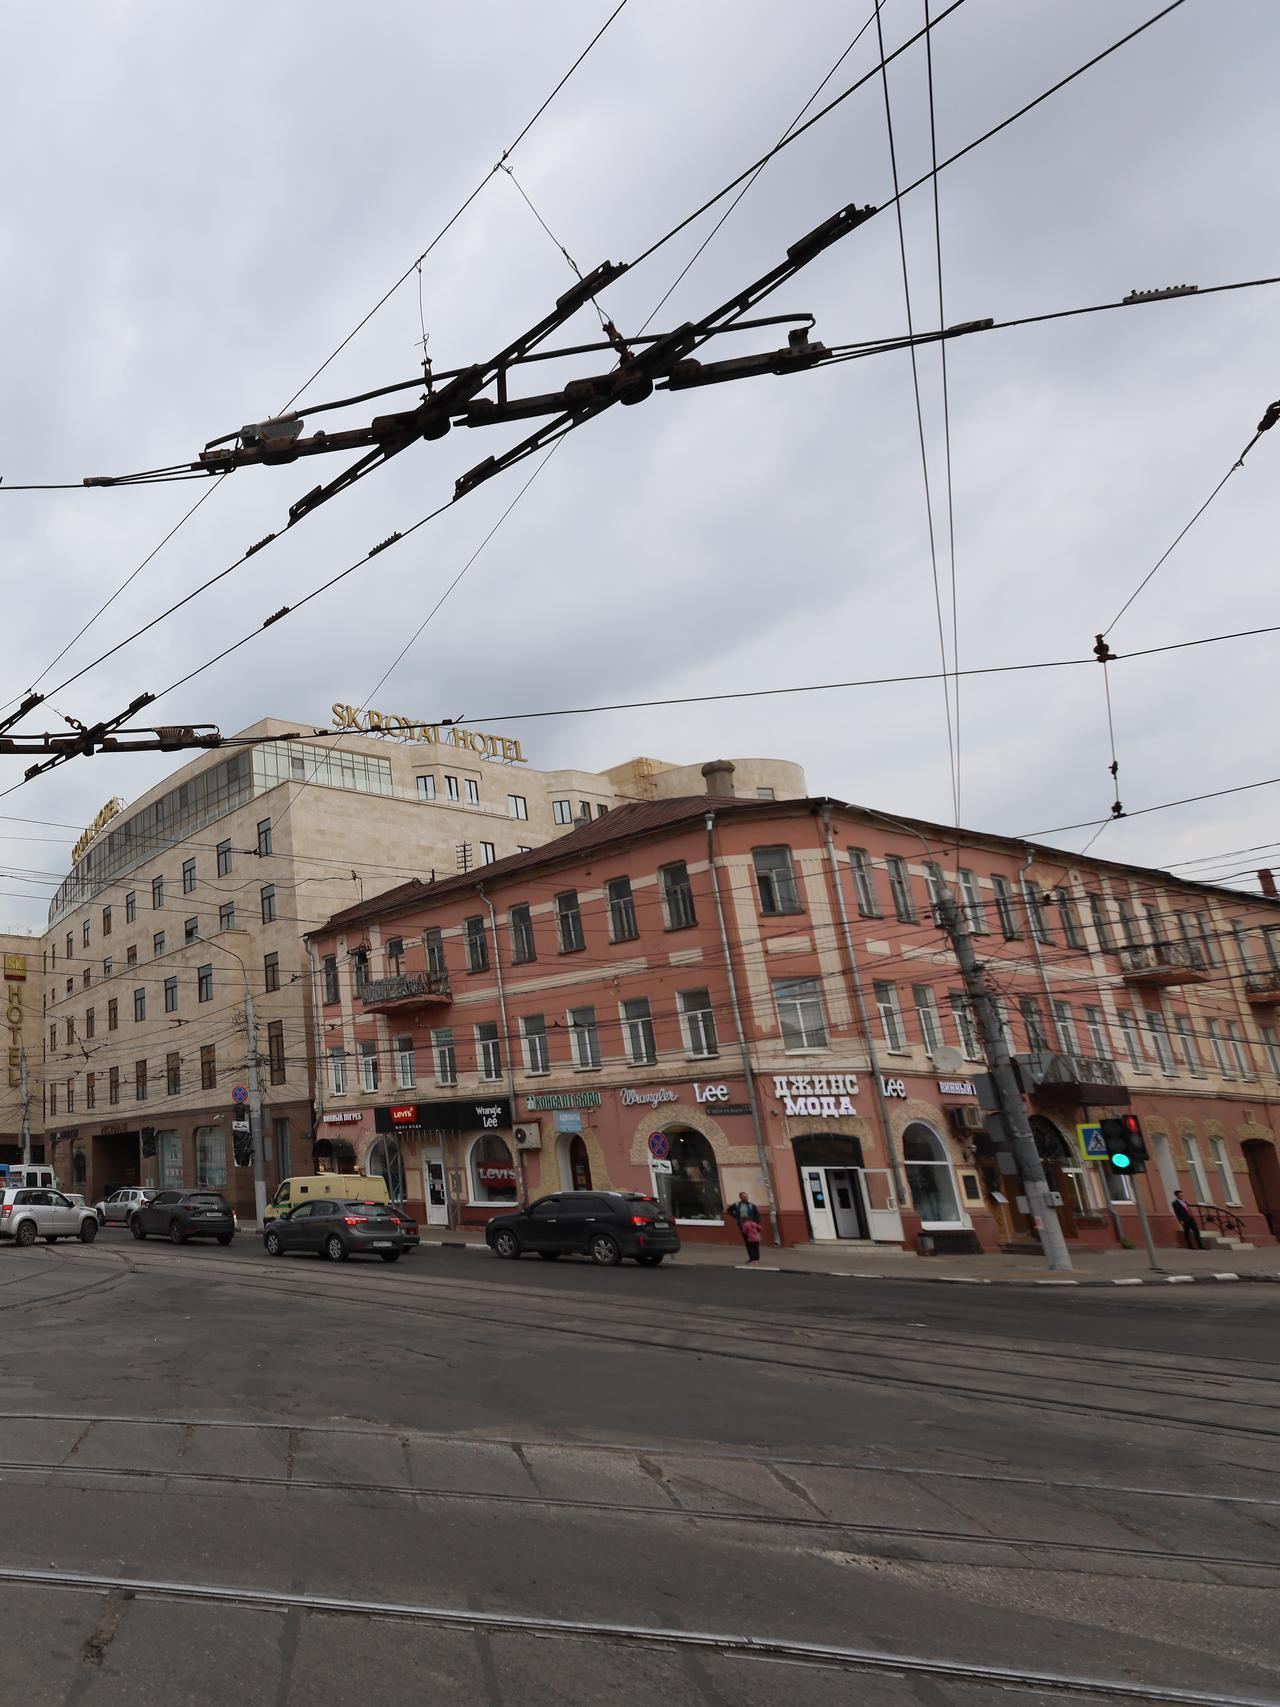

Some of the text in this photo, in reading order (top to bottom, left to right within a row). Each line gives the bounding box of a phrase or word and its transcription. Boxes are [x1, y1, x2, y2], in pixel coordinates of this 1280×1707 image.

[332, 703, 528, 762] SK ROYAL HOTEL
[8, 958, 24, 970] SK
[7, 984, 23, 1087] HOTEL
[620, 1083, 729, 1108] Wrangler Lee
[773, 1074, 859, 1098] ДЖИНС
[880, 1075, 906, 1098] Lee
[783, 1096, 856, 1118] МОДА
[482, 1116, 498, 1127] Lee
